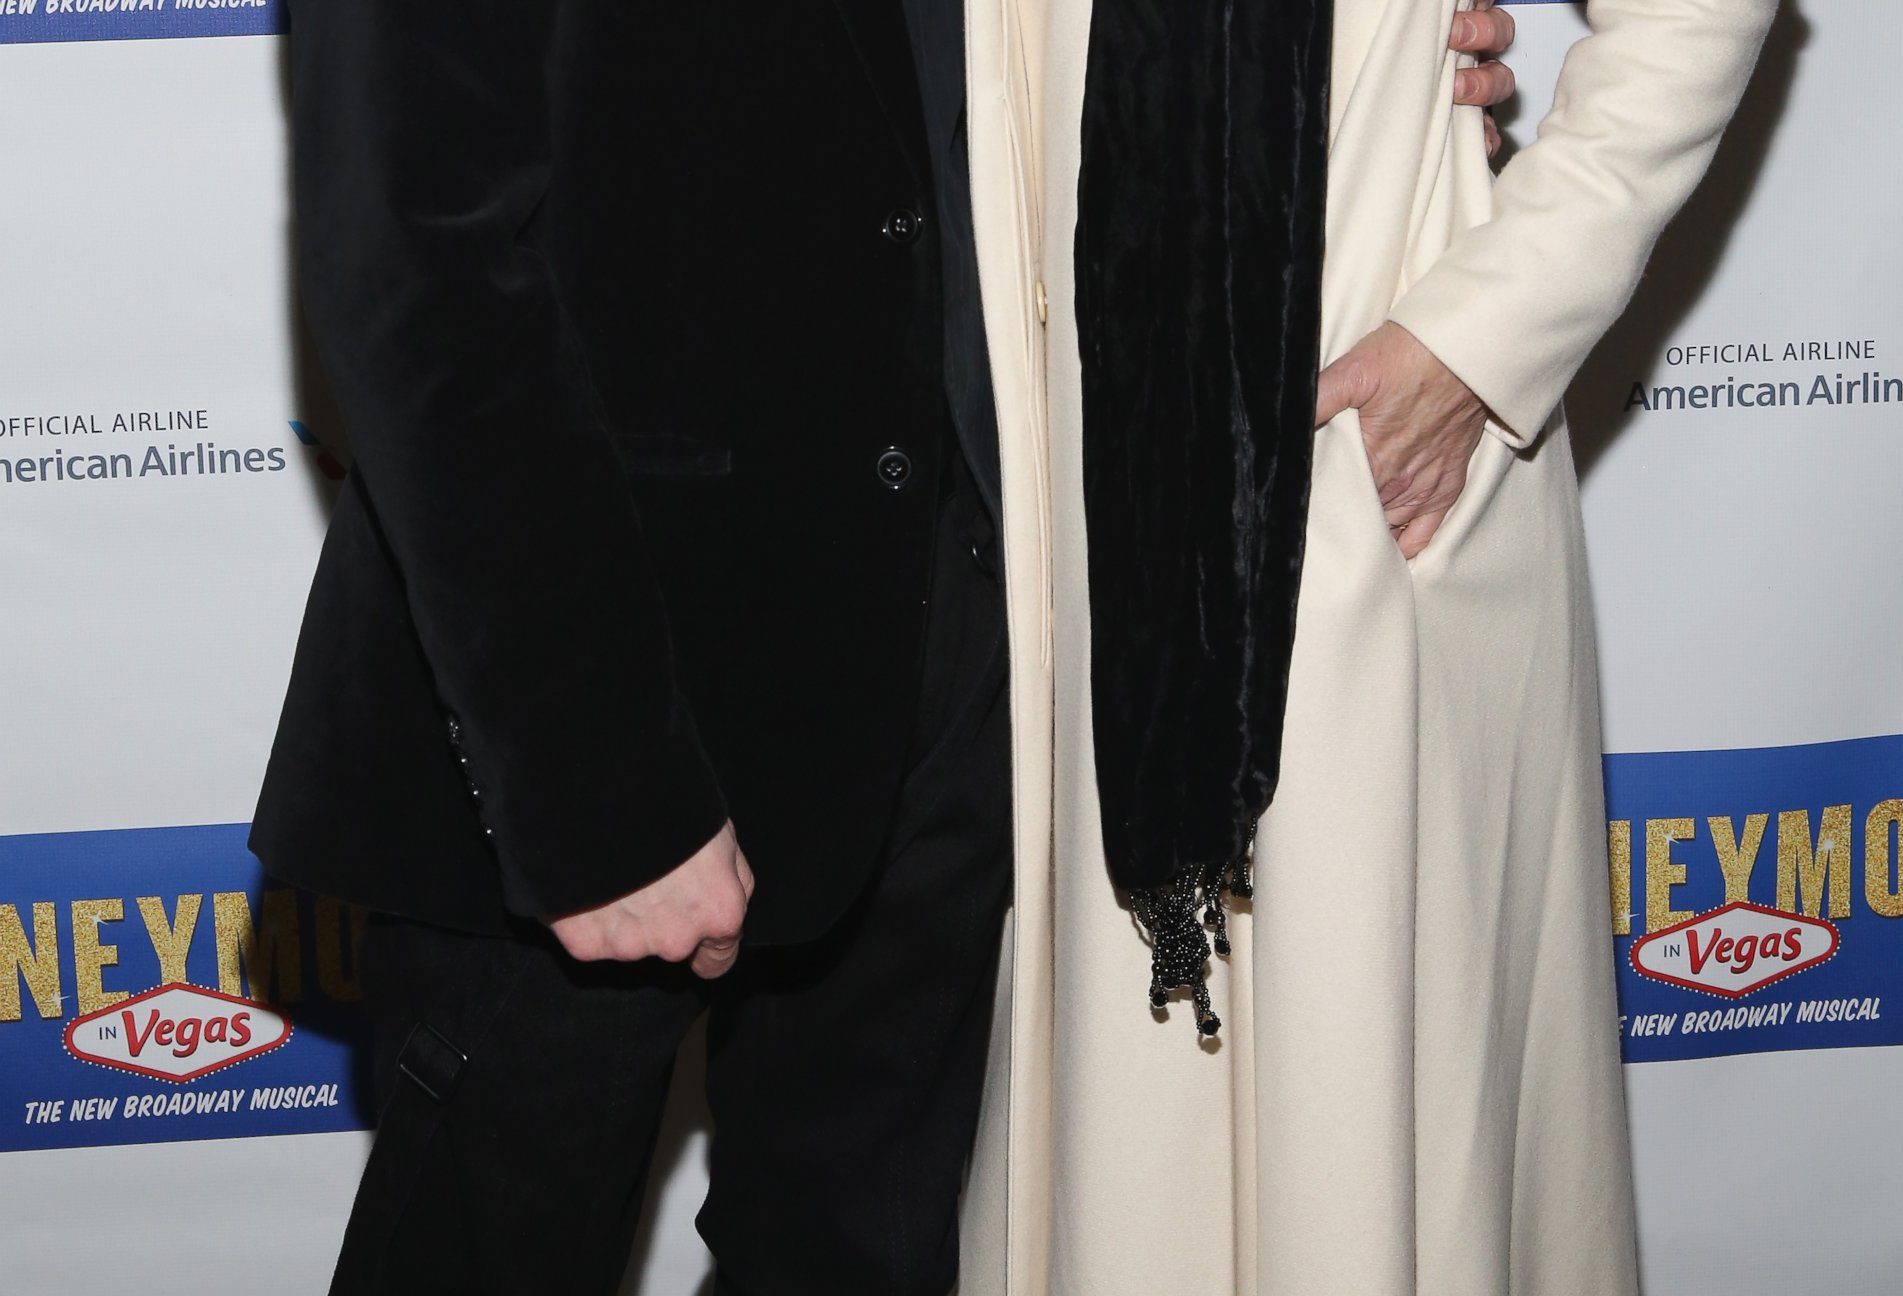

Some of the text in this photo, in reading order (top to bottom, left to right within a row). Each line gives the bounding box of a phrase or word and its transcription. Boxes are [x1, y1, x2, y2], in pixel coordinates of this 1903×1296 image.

[1666, 340, 1875, 365] OFFICIAL AIRLINE
[1624, 372, 1903, 412] American Airlin
[112, 410, 209, 433] AIRLINE
[139, 443, 286, 477] Airlines
[1664, 928, 1802, 975] IN Vegas
[99, 1009, 252, 1058] IN Vegas
[1630, 1013, 1678, 1037] NEW
[1681, 1002, 1793, 1035] BROADWAY
[1796, 998, 1881, 1023] MUSICAL
[25, 1084, 339, 1124] THE NEW BROADWAY MUSICAL
